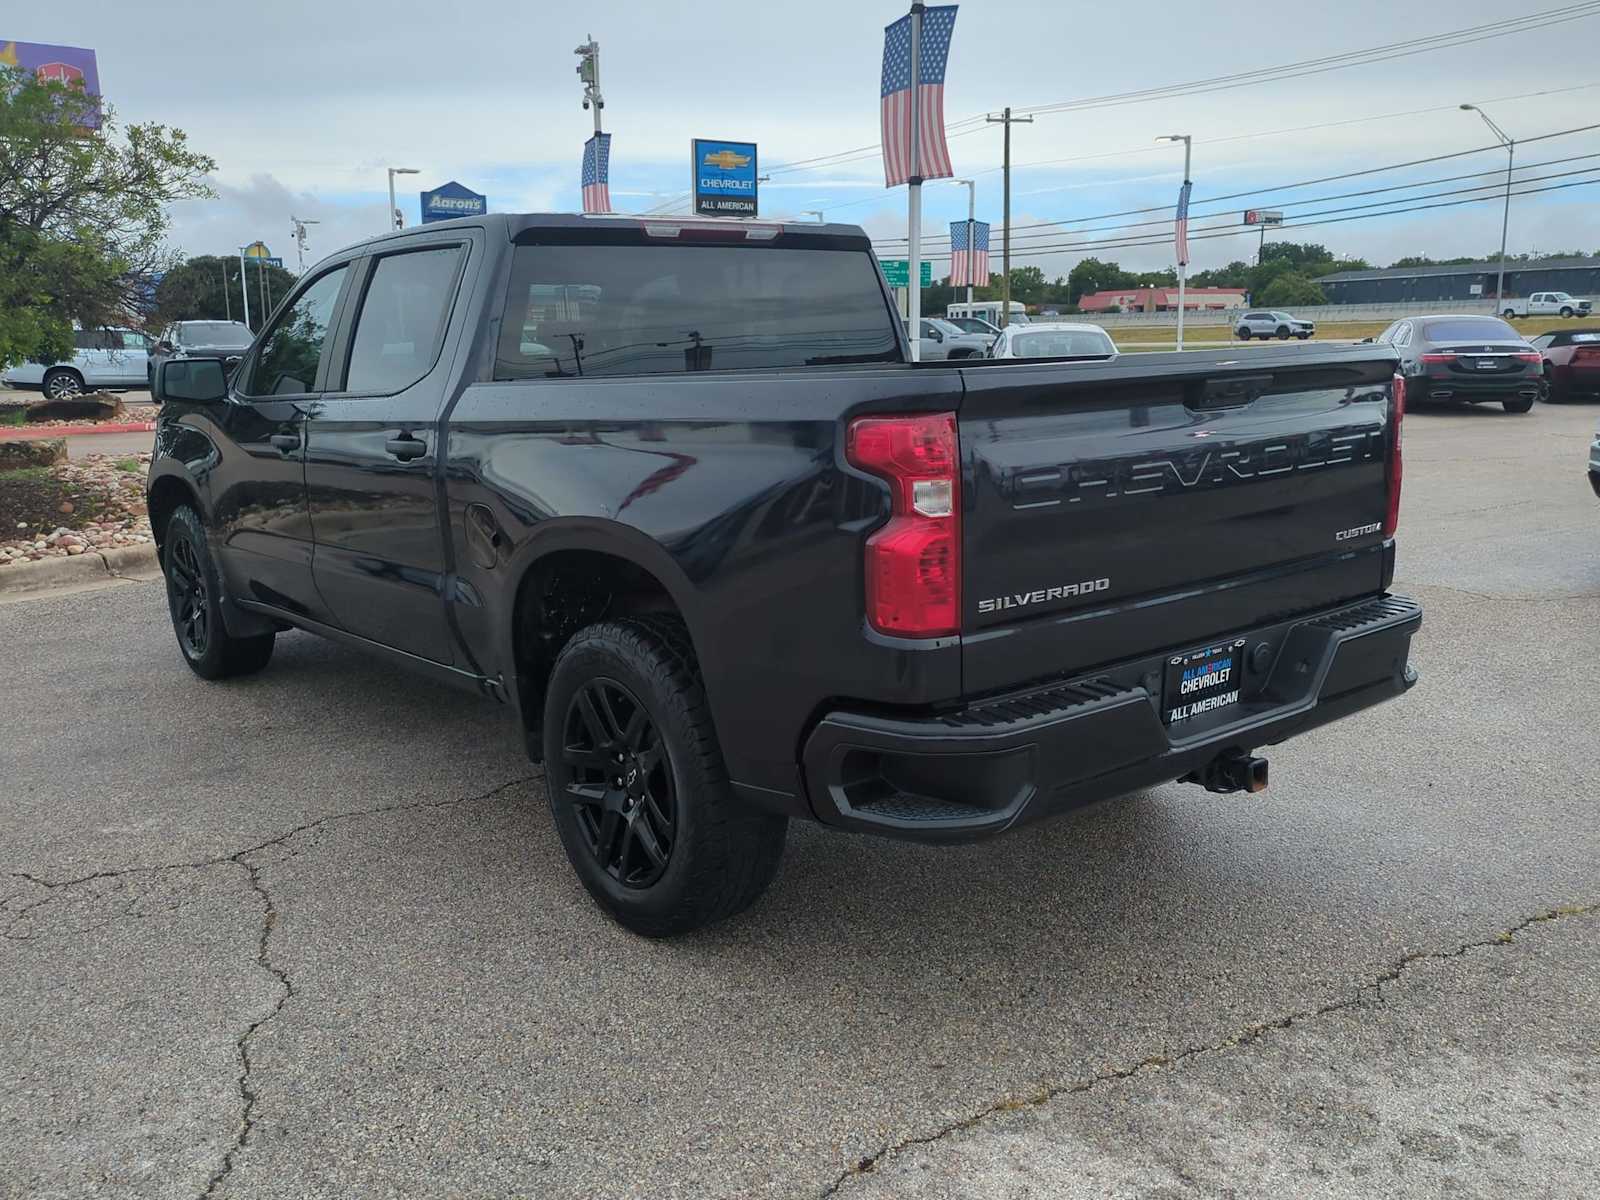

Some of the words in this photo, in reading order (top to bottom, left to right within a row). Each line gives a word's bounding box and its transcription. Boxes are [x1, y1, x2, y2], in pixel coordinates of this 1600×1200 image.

[701, 178, 753, 190] CHEVROLET
[429, 195, 481, 210] Aaron's
[701, 200, 715, 209] ALL
[717, 201, 754, 211] AMERICAN
[1012, 430, 1383, 509] CHEVROLET
[1335, 521, 1382, 541] CUSTOM
[978, 578, 1110, 613] SILVERADO
[1180, 667, 1232, 695] CHEVROLET
[1183, 667, 1196, 681] ALL
[1170, 705, 1189, 722] ALL
[1190, 690, 1239, 716] AMERICAN
